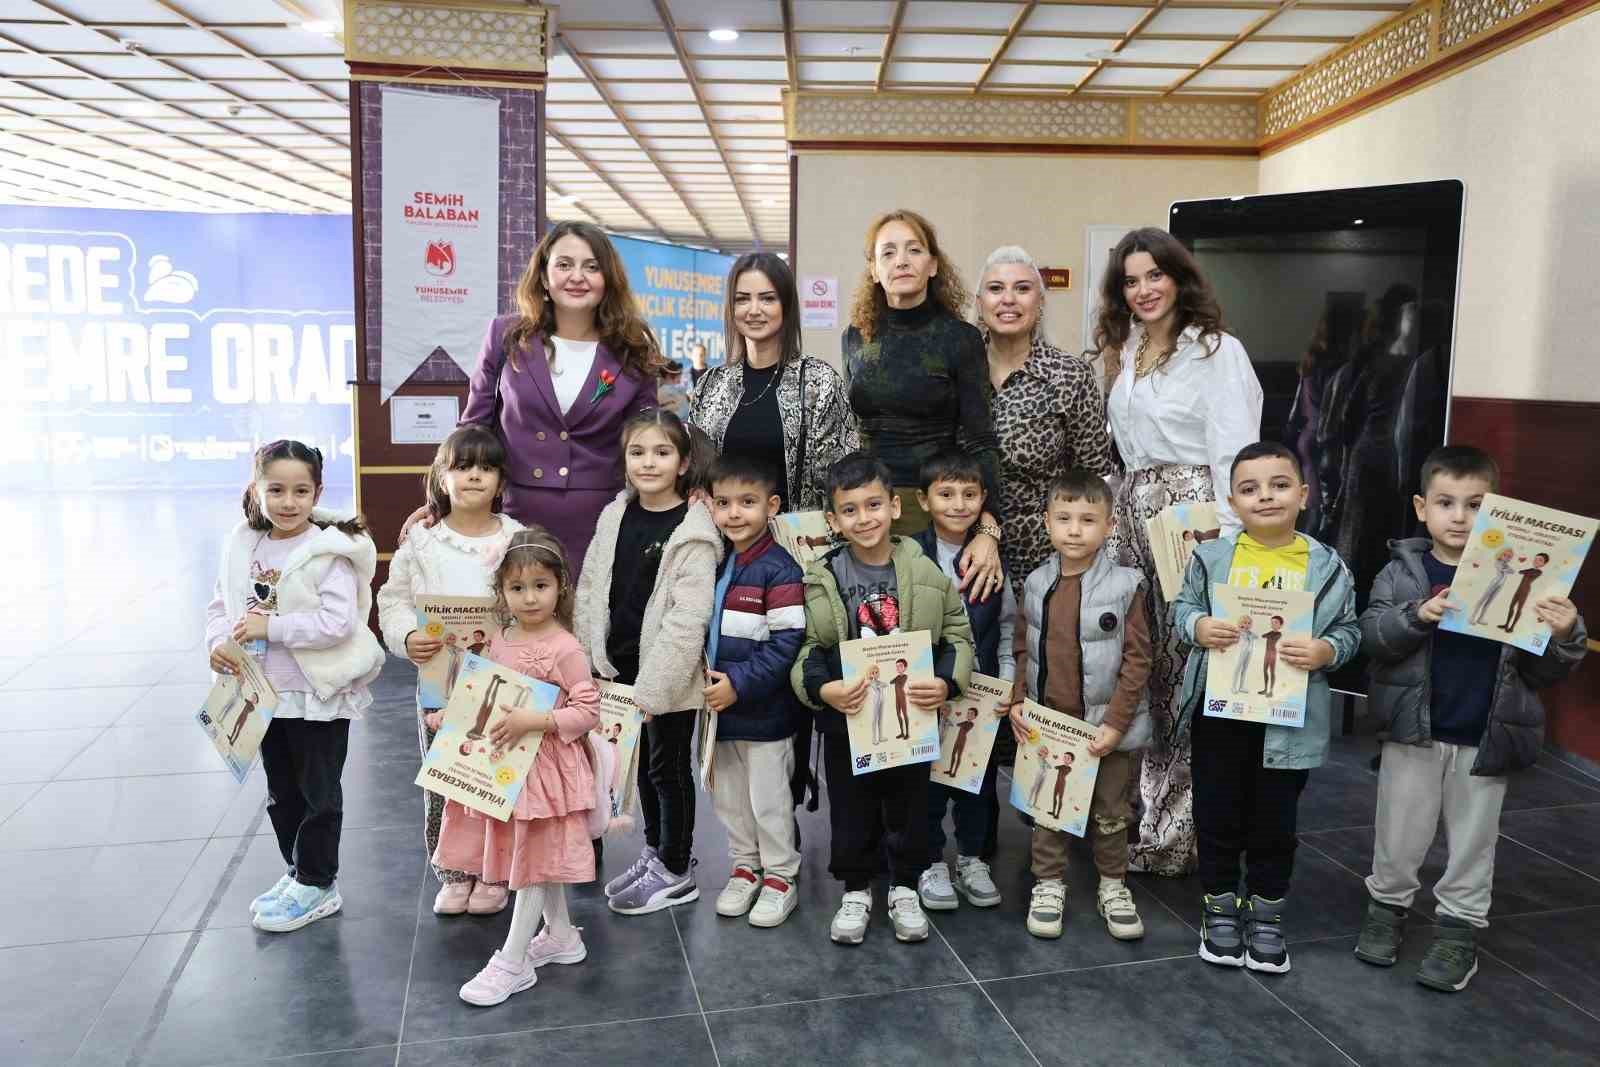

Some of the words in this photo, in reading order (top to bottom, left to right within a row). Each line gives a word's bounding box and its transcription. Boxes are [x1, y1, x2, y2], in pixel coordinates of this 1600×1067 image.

[404, 205, 480, 221] BALABAN
[645, 266, 721, 295] YUNUSEMRE
[1489, 505, 1524, 523] İYİLİK
[1524, 516, 1586, 538] MACERASI
[424, 604, 452, 614] İYİLİK
[1028, 711, 1052, 726] İYİLİK
[1052, 721, 1096, 741] MACERASI
[427, 767, 477, 794] MACERASI
[476, 788, 507, 808] İYİLİK
